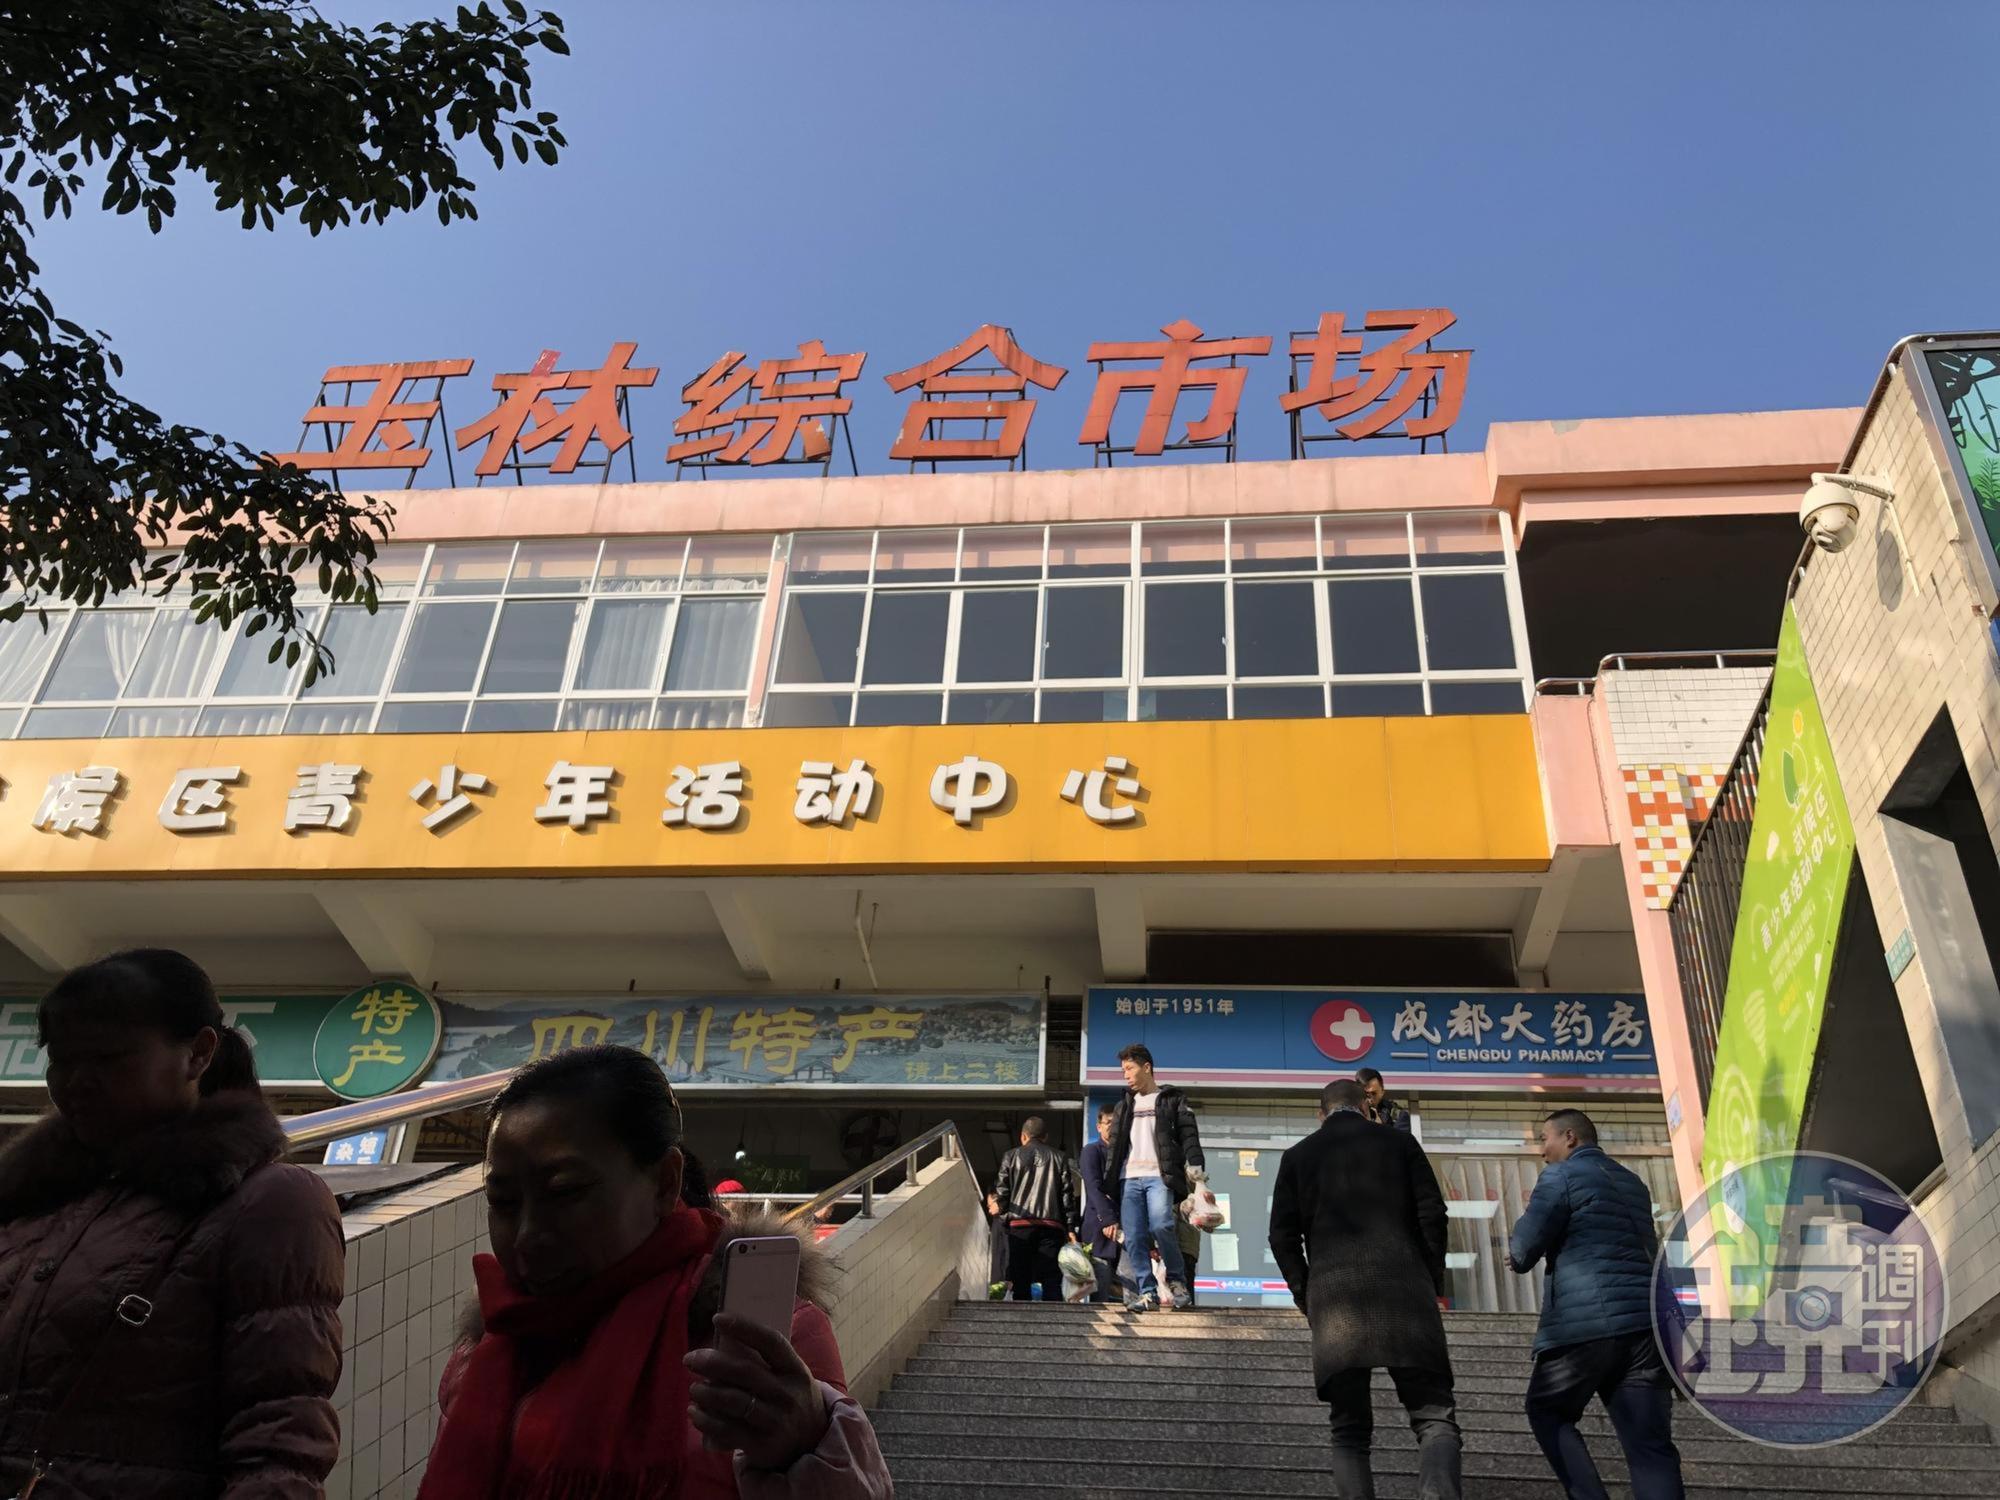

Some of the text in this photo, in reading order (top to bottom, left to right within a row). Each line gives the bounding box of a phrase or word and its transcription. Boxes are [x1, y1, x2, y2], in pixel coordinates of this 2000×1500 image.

[259, 308, 1473, 475] 玉林综合市场
[1115, 997, 1235, 1016] 始创于1951年
[1391, 999, 1646, 1048] 成都大药房
[332, 988, 420, 1087] 特产
[530, 1005, 924, 1075] 四川特产
[1435, 1048, 1606, 1064] CHENGDU PHARMACY
